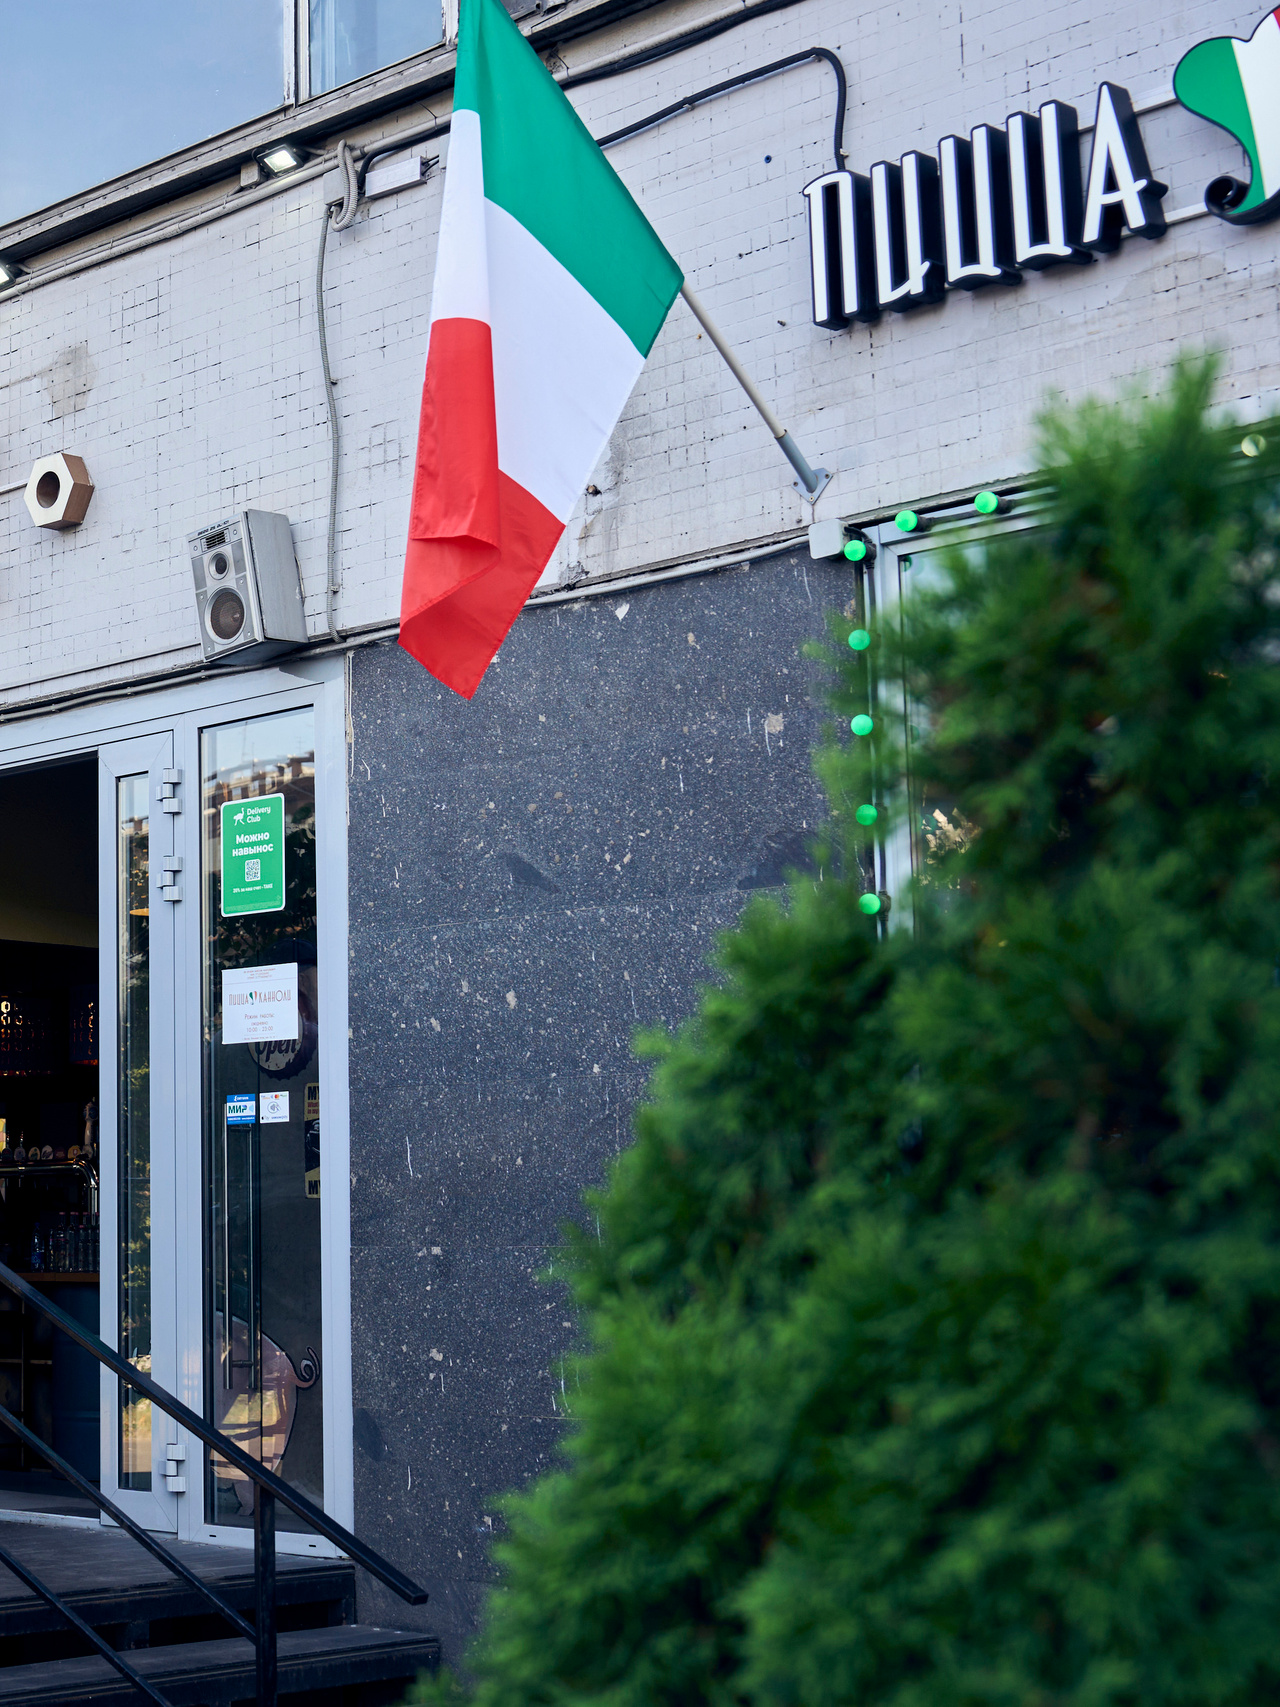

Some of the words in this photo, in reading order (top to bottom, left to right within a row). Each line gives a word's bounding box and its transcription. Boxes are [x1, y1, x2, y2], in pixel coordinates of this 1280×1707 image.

[803, 81, 1168, 331] ПИЦЦА
[247, 806, 271, 816] Delivery
[246, 815, 261, 824] Club
[236, 832, 270, 845] Можно
[232, 844, 274, 857] навынос
[259, 989, 291, 1004] КАННОЛИ
[228, 1104, 247, 1114] МИР
